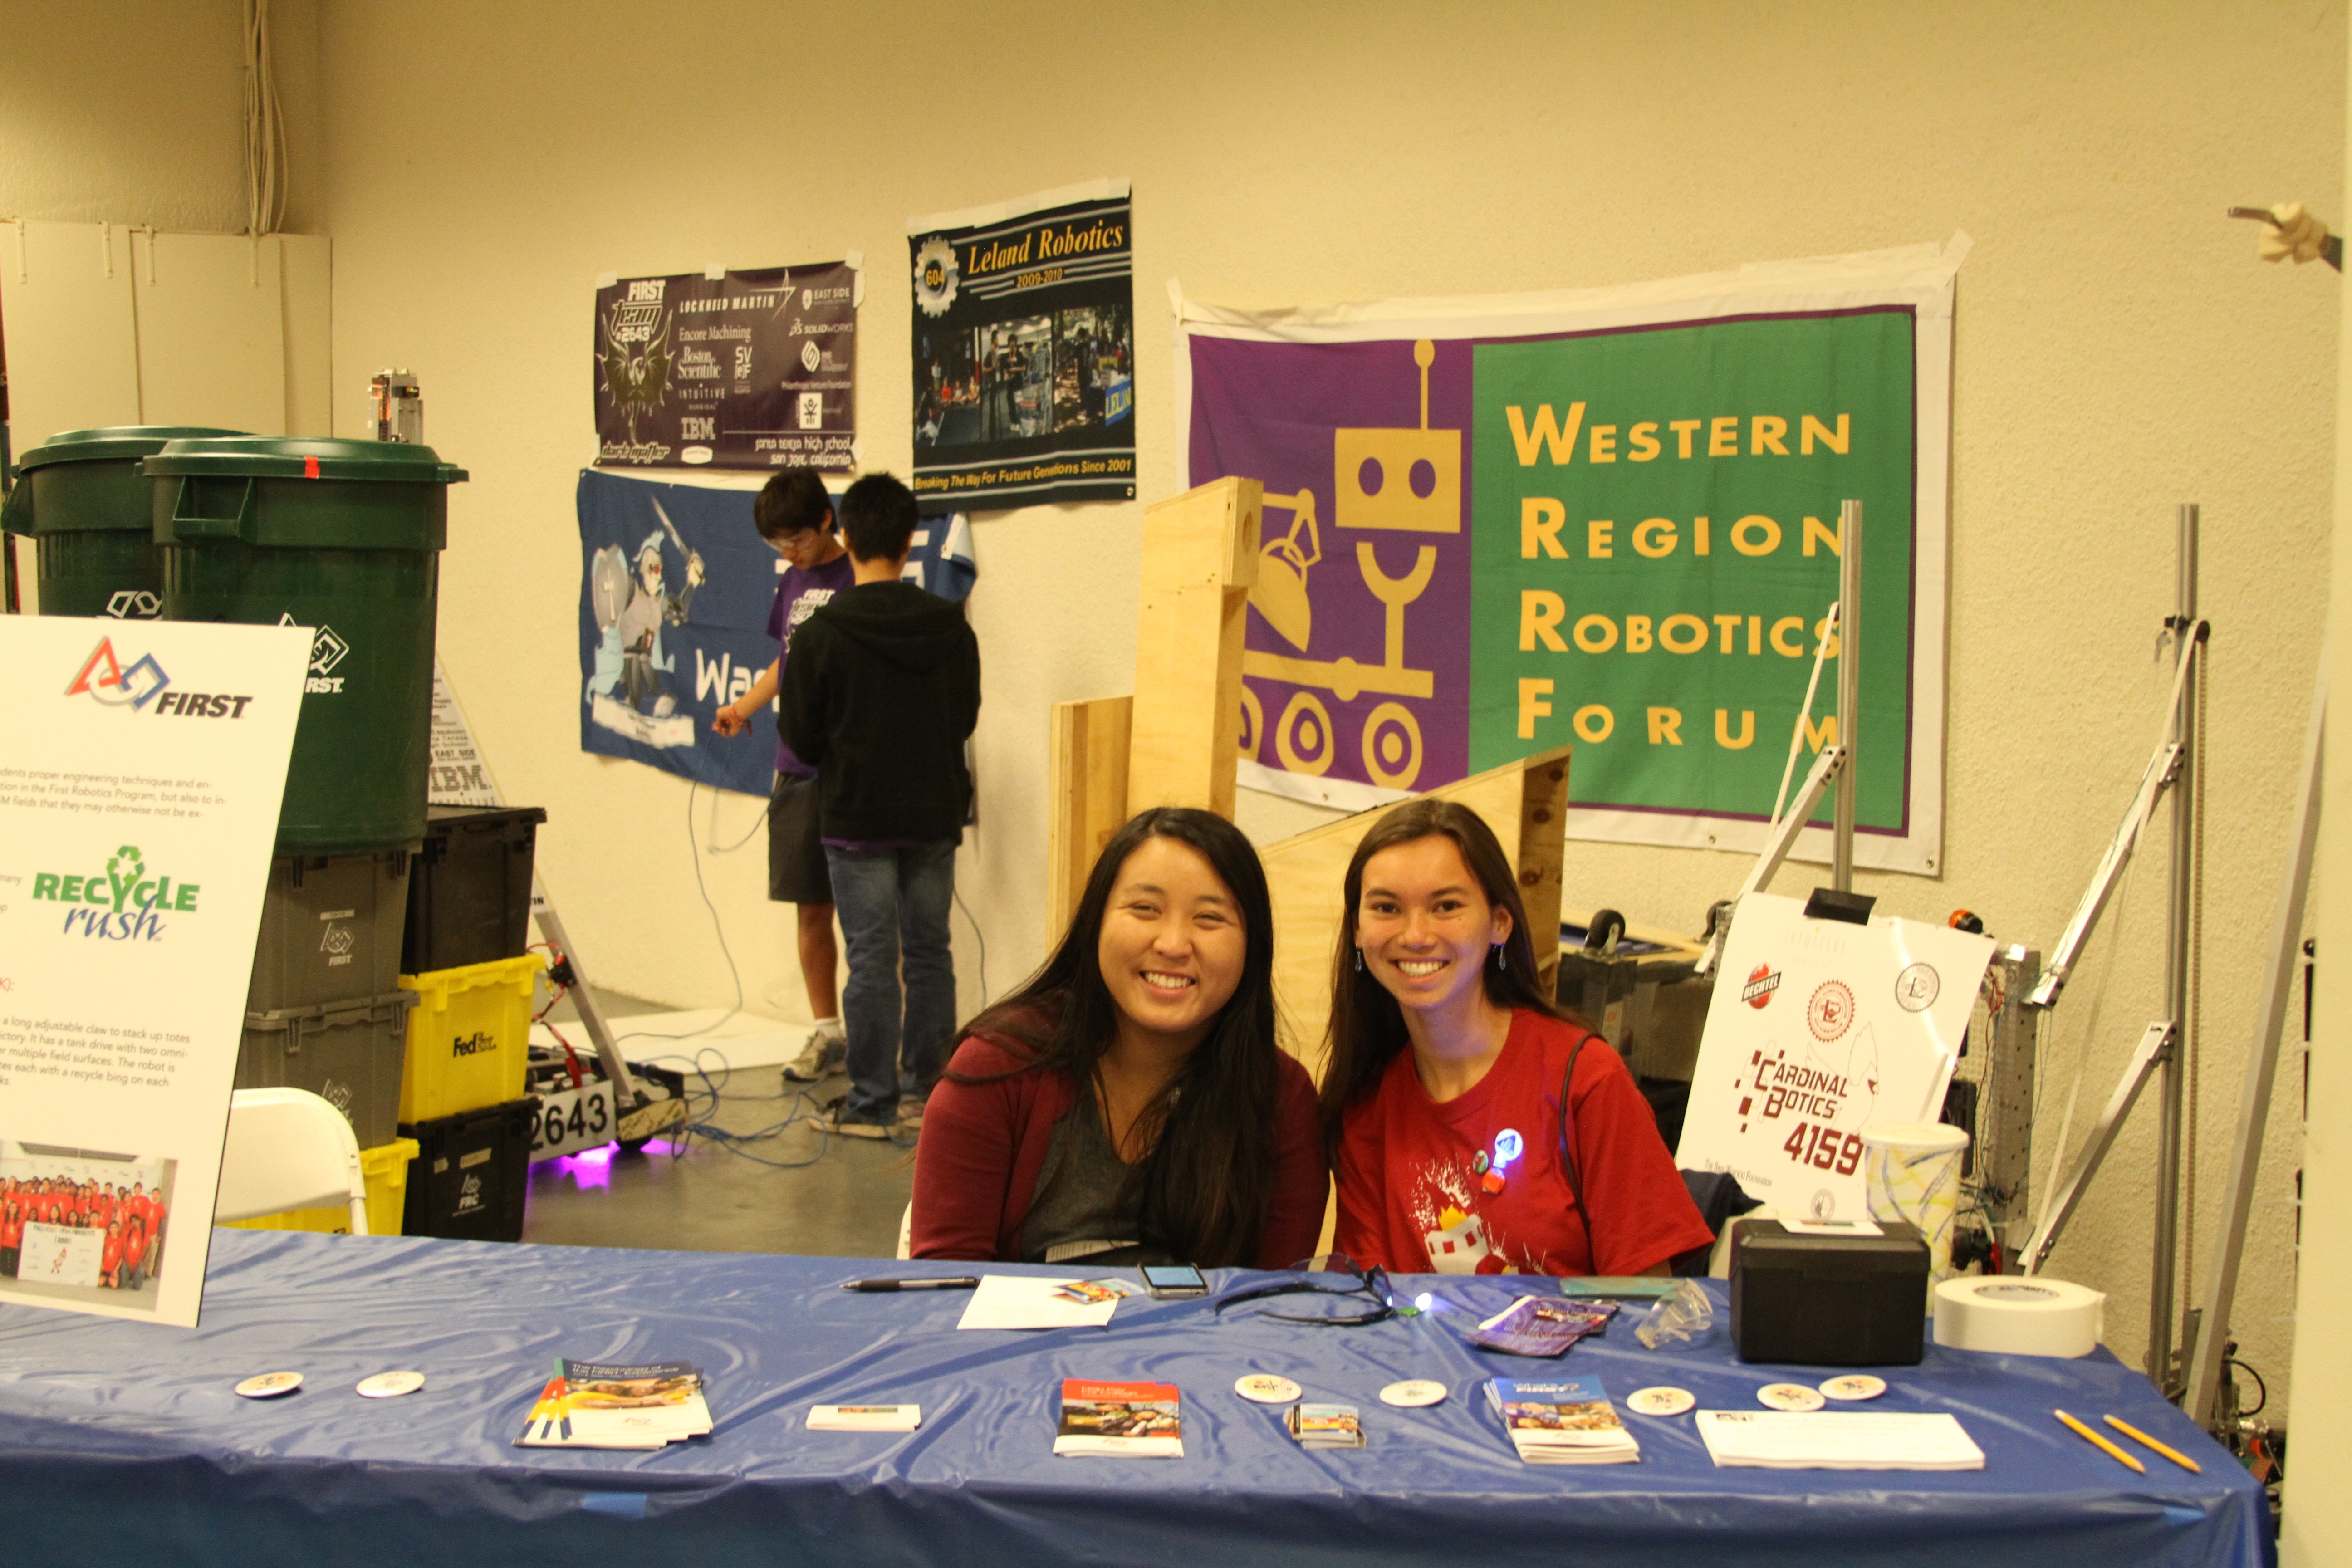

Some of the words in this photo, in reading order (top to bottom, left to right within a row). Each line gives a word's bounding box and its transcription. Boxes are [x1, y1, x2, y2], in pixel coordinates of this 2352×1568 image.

[968, 233, 1032, 275] Leland
[1039, 220, 1123, 260] Robotics
[926, 269, 944, 286] 604
[1017, 269, 1063, 289] 2009-2010
[628, 279, 666, 301] FIRST
[814, 289, 832, 299] EAST
[833, 287, 850, 299] SIDE
[680, 297, 728, 314] LOCKHEED
[732, 294, 775, 310] MARTIN
[680, 327, 707, 341] Encore
[709, 324, 751, 343] Machining
[735, 346, 753, 364] SV
[678, 358, 721, 379] Scientific
[681, 417, 715, 440] IBM
[804, 436, 823, 452] high
[952, 475, 965, 487] The
[982, 471, 997, 485] For
[999, 469, 1032, 482] Future
[1080, 460, 1106, 474] Since
[1107, 459, 1132, 472] 2001
[1520, 497, 1843, 560] REGION
[155, 692, 253, 720] FIRST
[29, 771, 59, 780] proper
[63, 772, 118, 786] engineering
[122, 775, 172, 788] techniques
[176, 779, 195, 789] and
[20, 783, 28, 792] in
[31, 784, 46, 793] the
[49, 784, 69, 794] First
[72, 785, 112, 797] Robotics
[115, 788, 157, 802] Program,
[161, 791, 177, 802] but
[180, 793, 199, 804] also
[202, 796, 212, 804] to
[13, 795, 37, 807] fields
[40, 798, 58, 808] that
[61, 799, 81, 813] they
[84, 803, 103, 814] may
[106, 804, 151, 815] otherwise
[154, 808, 170, 816] not
[173, 807, 186, 817] be
[32, 862, 201, 914] RECYCLE
[63, 893, 167, 942] rush
[1743, 973, 1780, 999] BECHTEL
[11, 1015, 32, 1030] long
[34, 1018, 83, 1033] adjustable
[86, 1024, 107, 1034] claw
[110, 1028, 120, 1036] to
[122, 1028, 147, 1039] stack
[150, 1033, 163, 1043] up
[166, 1033, 190, 1044] totes
[30, 1033, 36, 1043] It
[40, 1034, 55, 1045] has
[67, 1038, 86, 1048] tank
[90, 1039, 113, 1051] drive
[116, 1043, 136, 1053] with
[139, 1045, 157, 1055] two
[9, 1047, 47, 1061] multiple
[50, 1049, 71, 1062] field
[73, 1053, 113, 1067] surfaces.
[118, 1056, 135, 1068] The
[138, 1059, 165, 1072] robot
[167, 1062, 175, 1073] is
[15, 1063, 37, 1073] each
[39, 1064, 59, 1076] with
[70, 1070, 104, 1082] recycle
[107, 1071, 128, 1086] bing
[131, 1077, 143, 1085] on
[146, 1077, 169, 1087] each
[1755, 1059, 1847, 1098] CARDINAL
[1764, 1086, 1838, 1119] BOTICS
[1784, 1122, 1864, 1176] 4159
